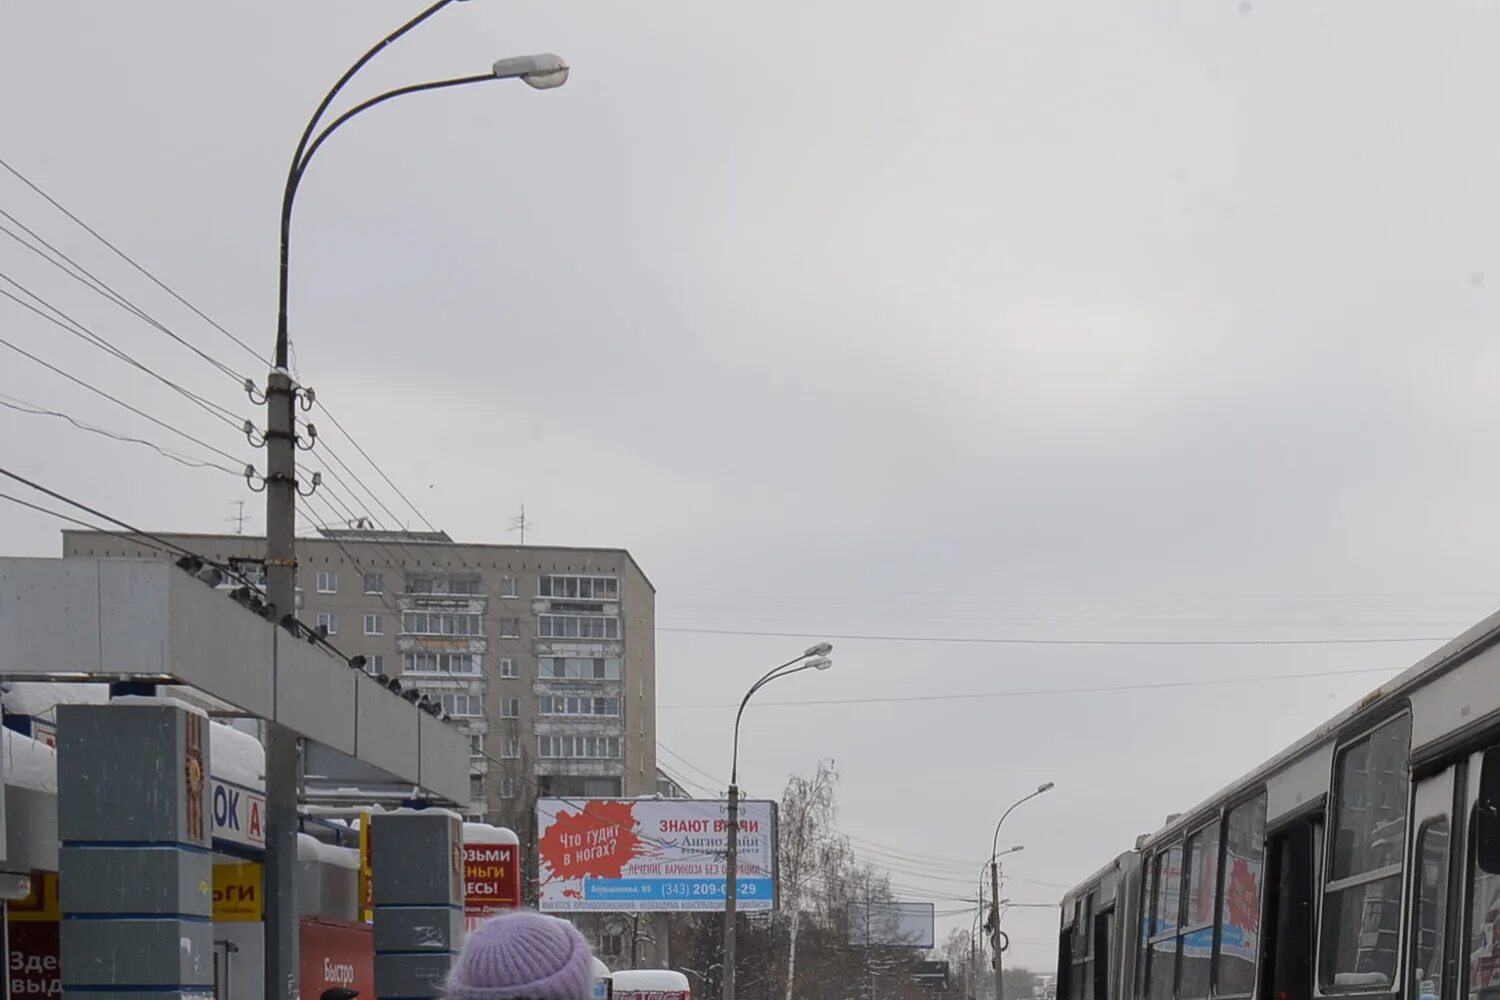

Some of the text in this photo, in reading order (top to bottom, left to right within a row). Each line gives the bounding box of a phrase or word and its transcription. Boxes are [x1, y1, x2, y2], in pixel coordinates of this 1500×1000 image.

[660, 820, 709, 833] ЗНАЮТ
[561, 824, 620, 849] Что гудит
[563, 838, 617, 866] в ногах?
[465, 867, 505, 878] НЬГИ
[628, 863, 661, 875] ЛЕЧЕНИЕ
[665, 863, 703, 875] ВАРИКОЗА
[705, 863, 719, 875] БЕЗ
[465, 882, 499, 895] ЕСЬ!
[661, 883, 690, 896] (343)
[324, 958, 355, 989] Быстро
